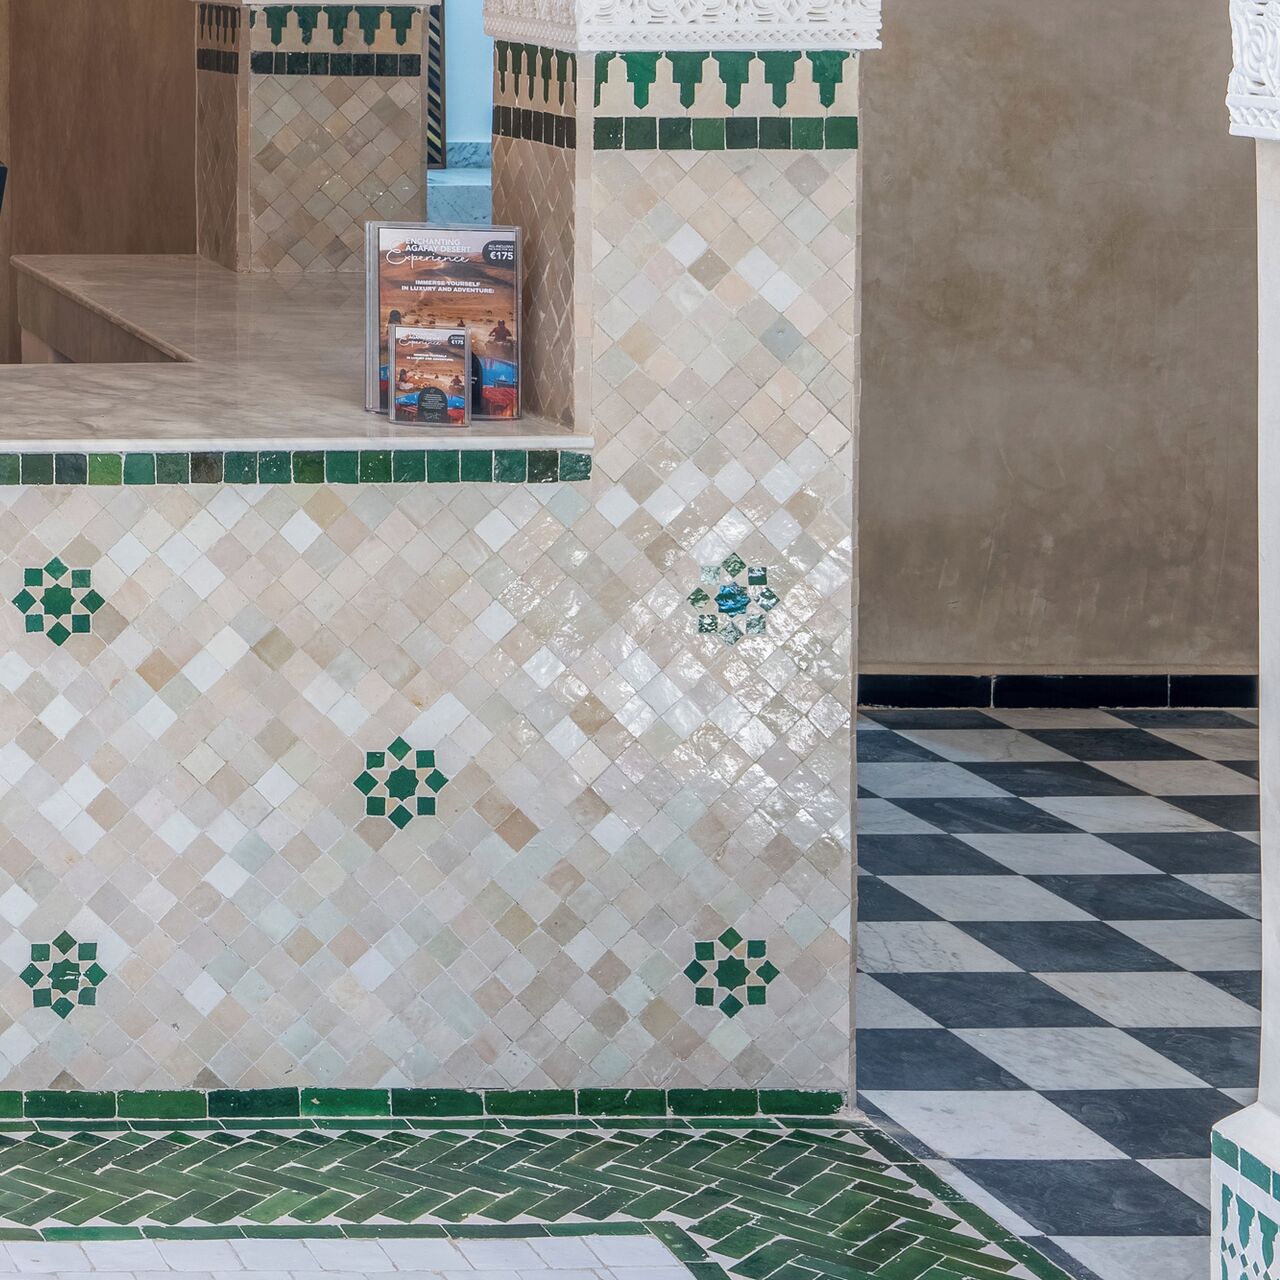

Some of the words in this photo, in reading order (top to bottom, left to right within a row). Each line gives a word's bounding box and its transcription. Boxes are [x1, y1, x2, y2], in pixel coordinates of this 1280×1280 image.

[405, 238, 460, 246] ENCHANTING
[405, 244, 439, 253] AGAFAY
[386, 244, 470, 269] Experience
[490, 251, 513, 260] €175
